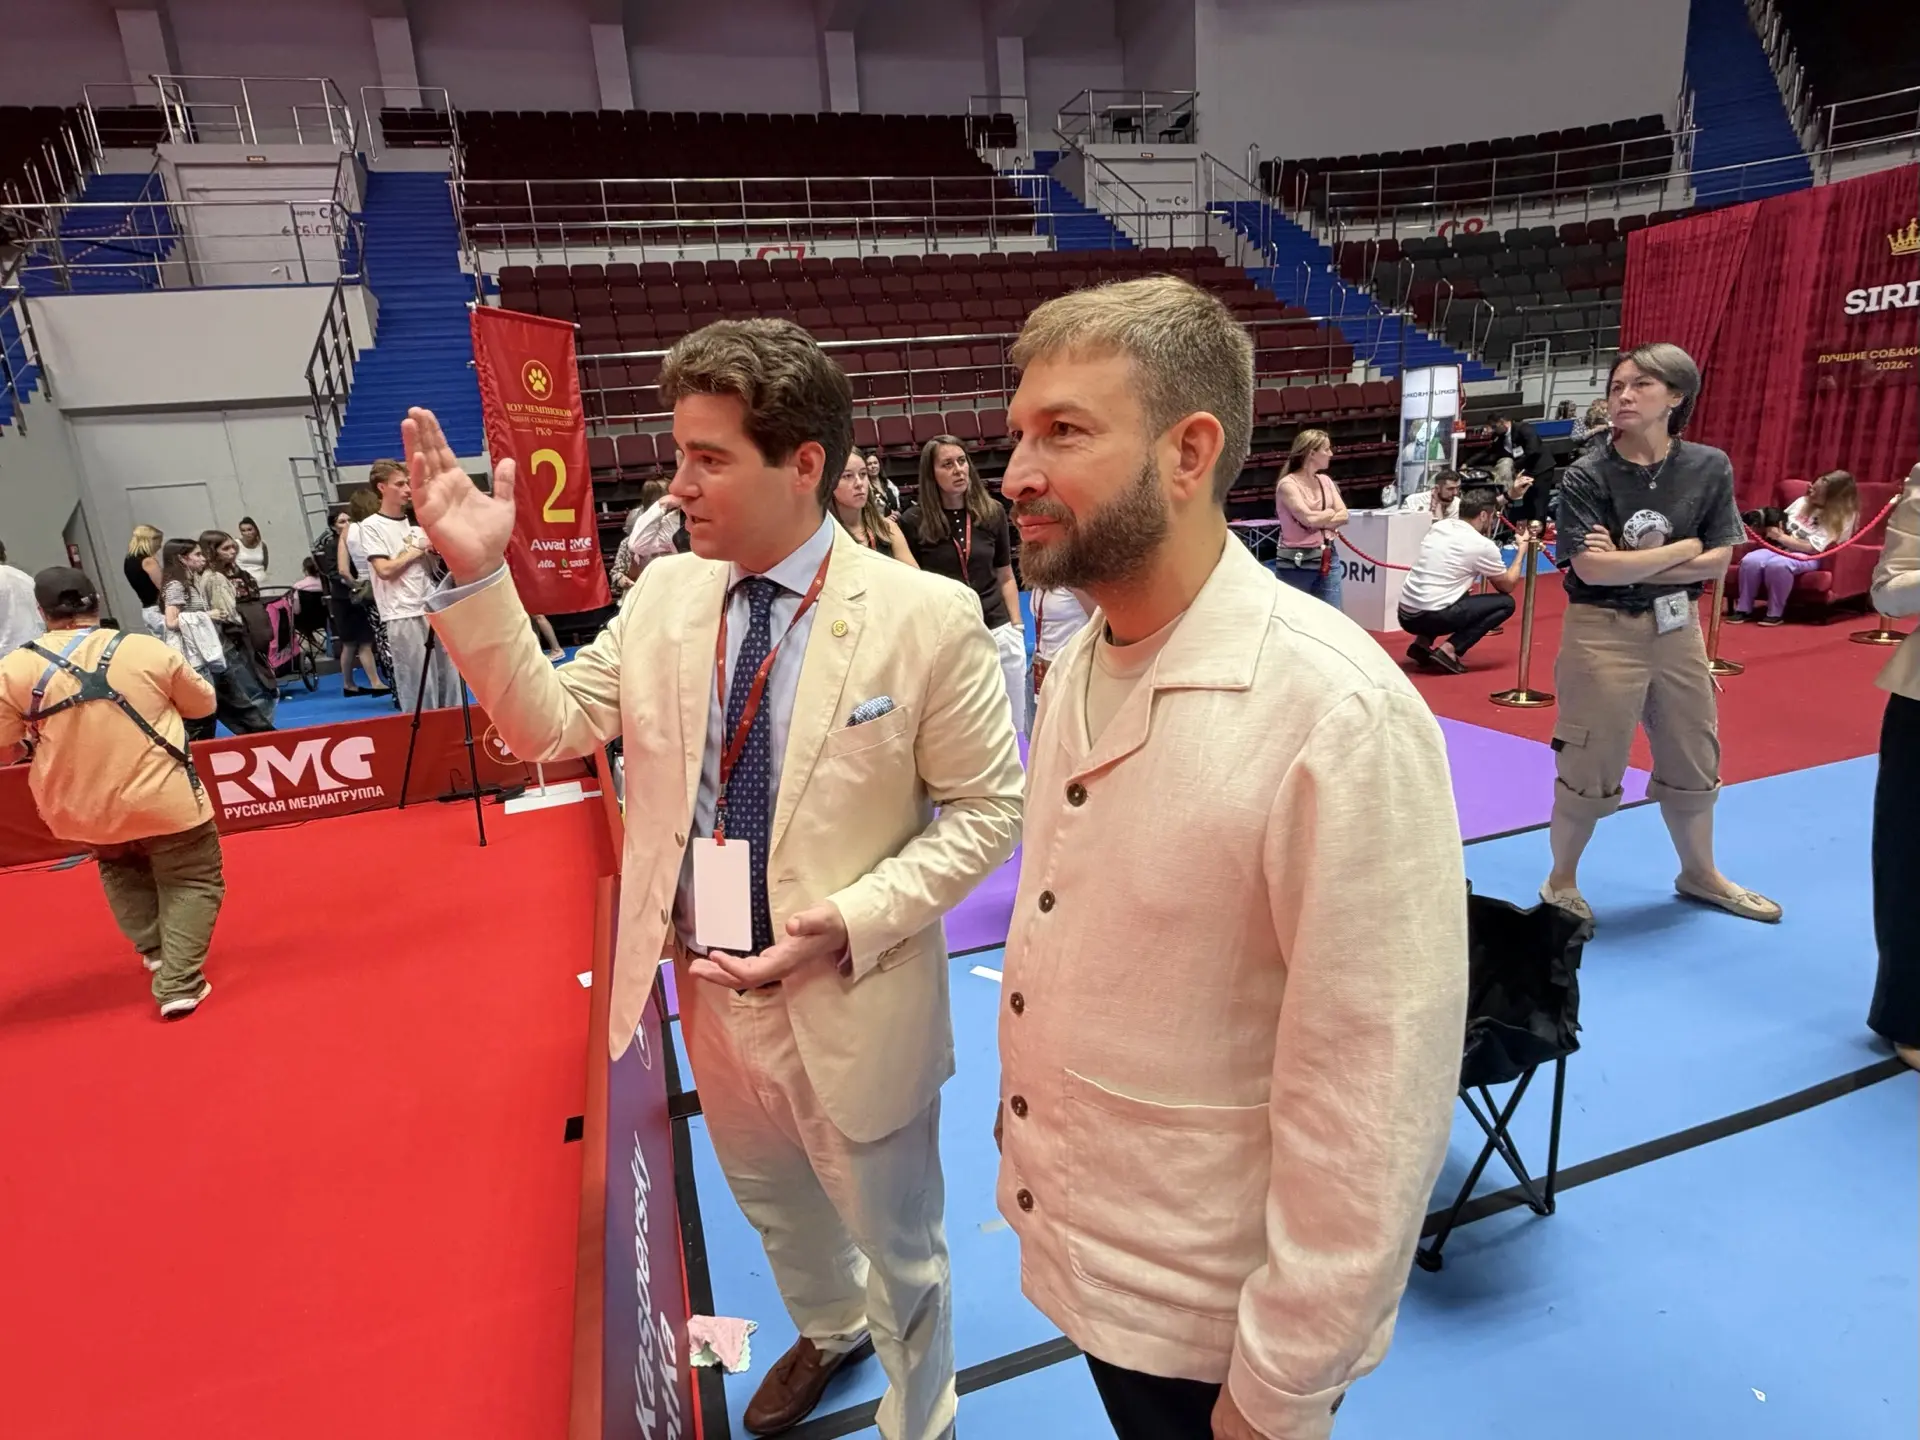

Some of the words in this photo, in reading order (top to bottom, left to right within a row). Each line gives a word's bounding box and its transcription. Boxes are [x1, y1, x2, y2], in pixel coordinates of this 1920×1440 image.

[1818, 351, 1867, 364] ЛУЧШИЕ
[1876, 360, 1914, 371] 2026г.
[535, 426, 552, 436] РКФ
[530, 448, 576, 523] 2
[223, 800, 286, 820] РУССКАЯ
[288, 784, 385, 808] МЕДИАГРУППА
[631, 1130, 657, 1440] Kaspersky
